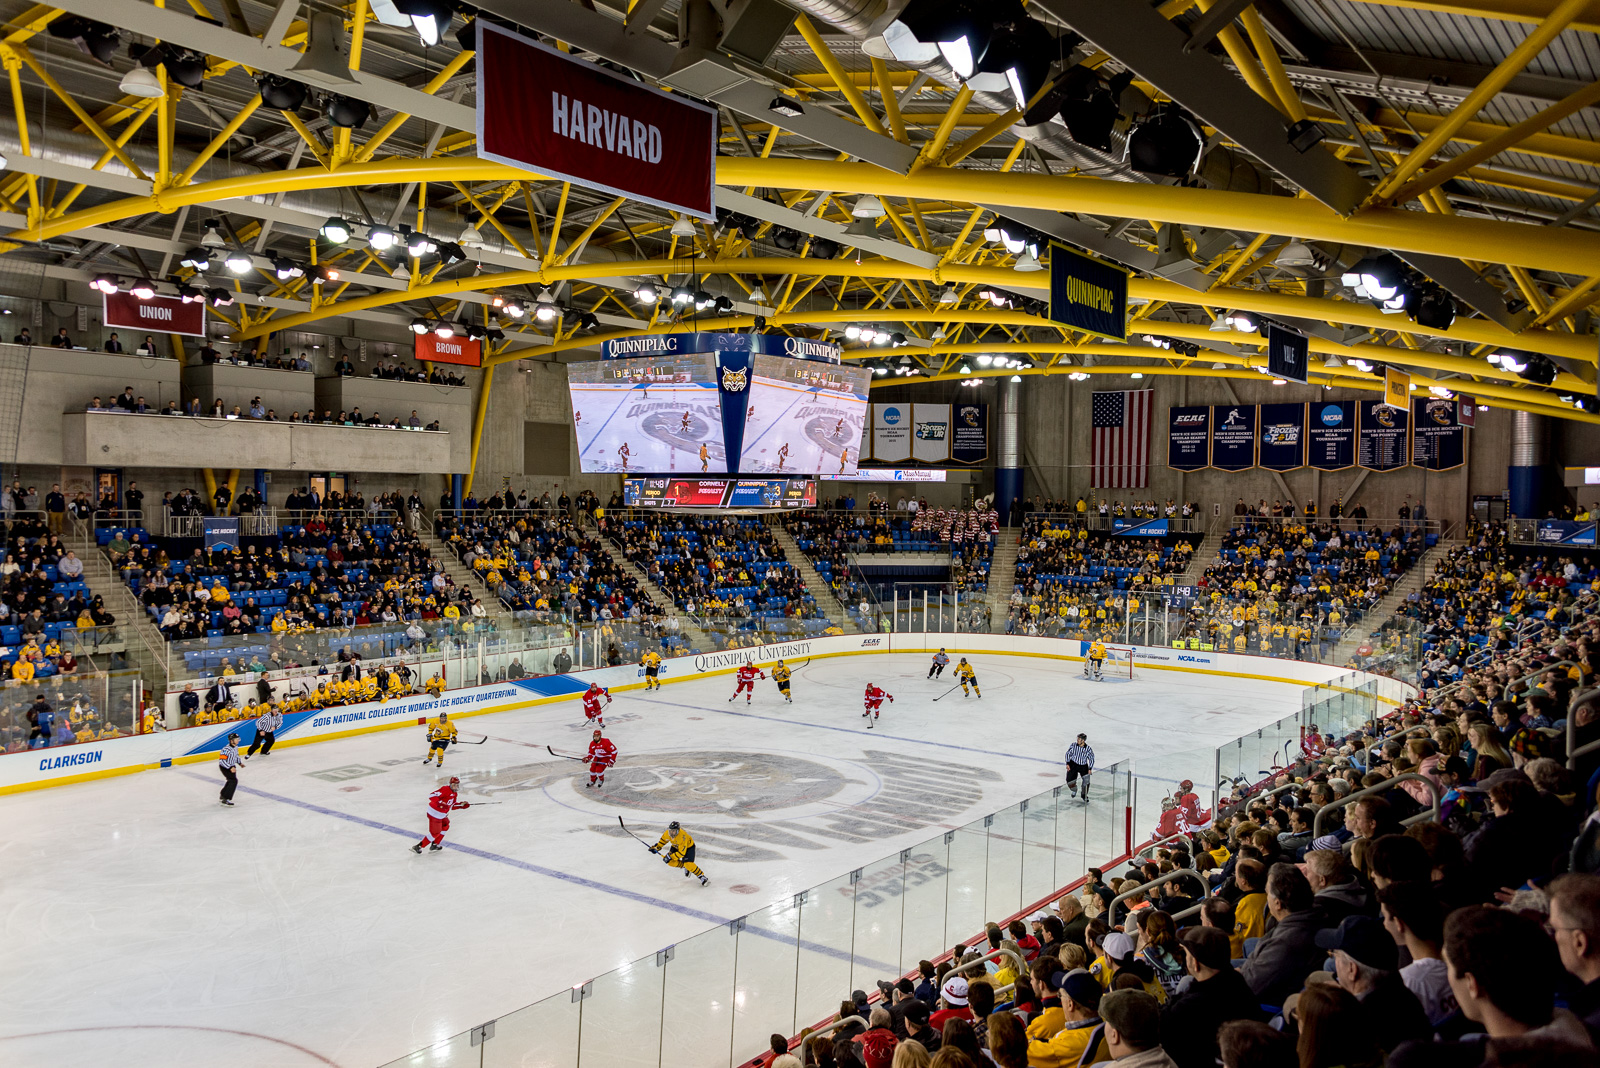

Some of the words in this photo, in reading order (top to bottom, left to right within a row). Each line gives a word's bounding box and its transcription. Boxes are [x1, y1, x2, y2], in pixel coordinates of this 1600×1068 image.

[552, 90, 663, 164] HARVARD
[1066, 275, 1113, 314] QUINNIPIAC
[140, 305, 172, 321] UNION
[436, 342, 462, 356] BROWN
[608, 337, 677, 357] QUINNIPIAC
[784, 337, 838, 360] QUINNIPIAC
[674, 485, 679, 495] 1
[775, 486, 780, 496] 3
[694, 651, 755, 673] QUINNIPIAC
[758, 642, 812, 661] UNIVERSITY
[1178, 655, 1210, 664] NCAA.com
[638, 665, 668, 678] QUIAC
[312, 716, 331, 727] 2016
[332, 712, 366, 724] NATIONAL
[368, 706, 407, 718] COLLEGIATE
[408, 700, 438, 712] WOMEN'S
[440, 698, 450, 708] ICE
[451, 694, 476, 706] HOCKEY
[476, 688, 518, 702] QUARTERFINAL
[39, 750, 103, 771] CLARKSON
[1176, 819, 1190, 835] 30
